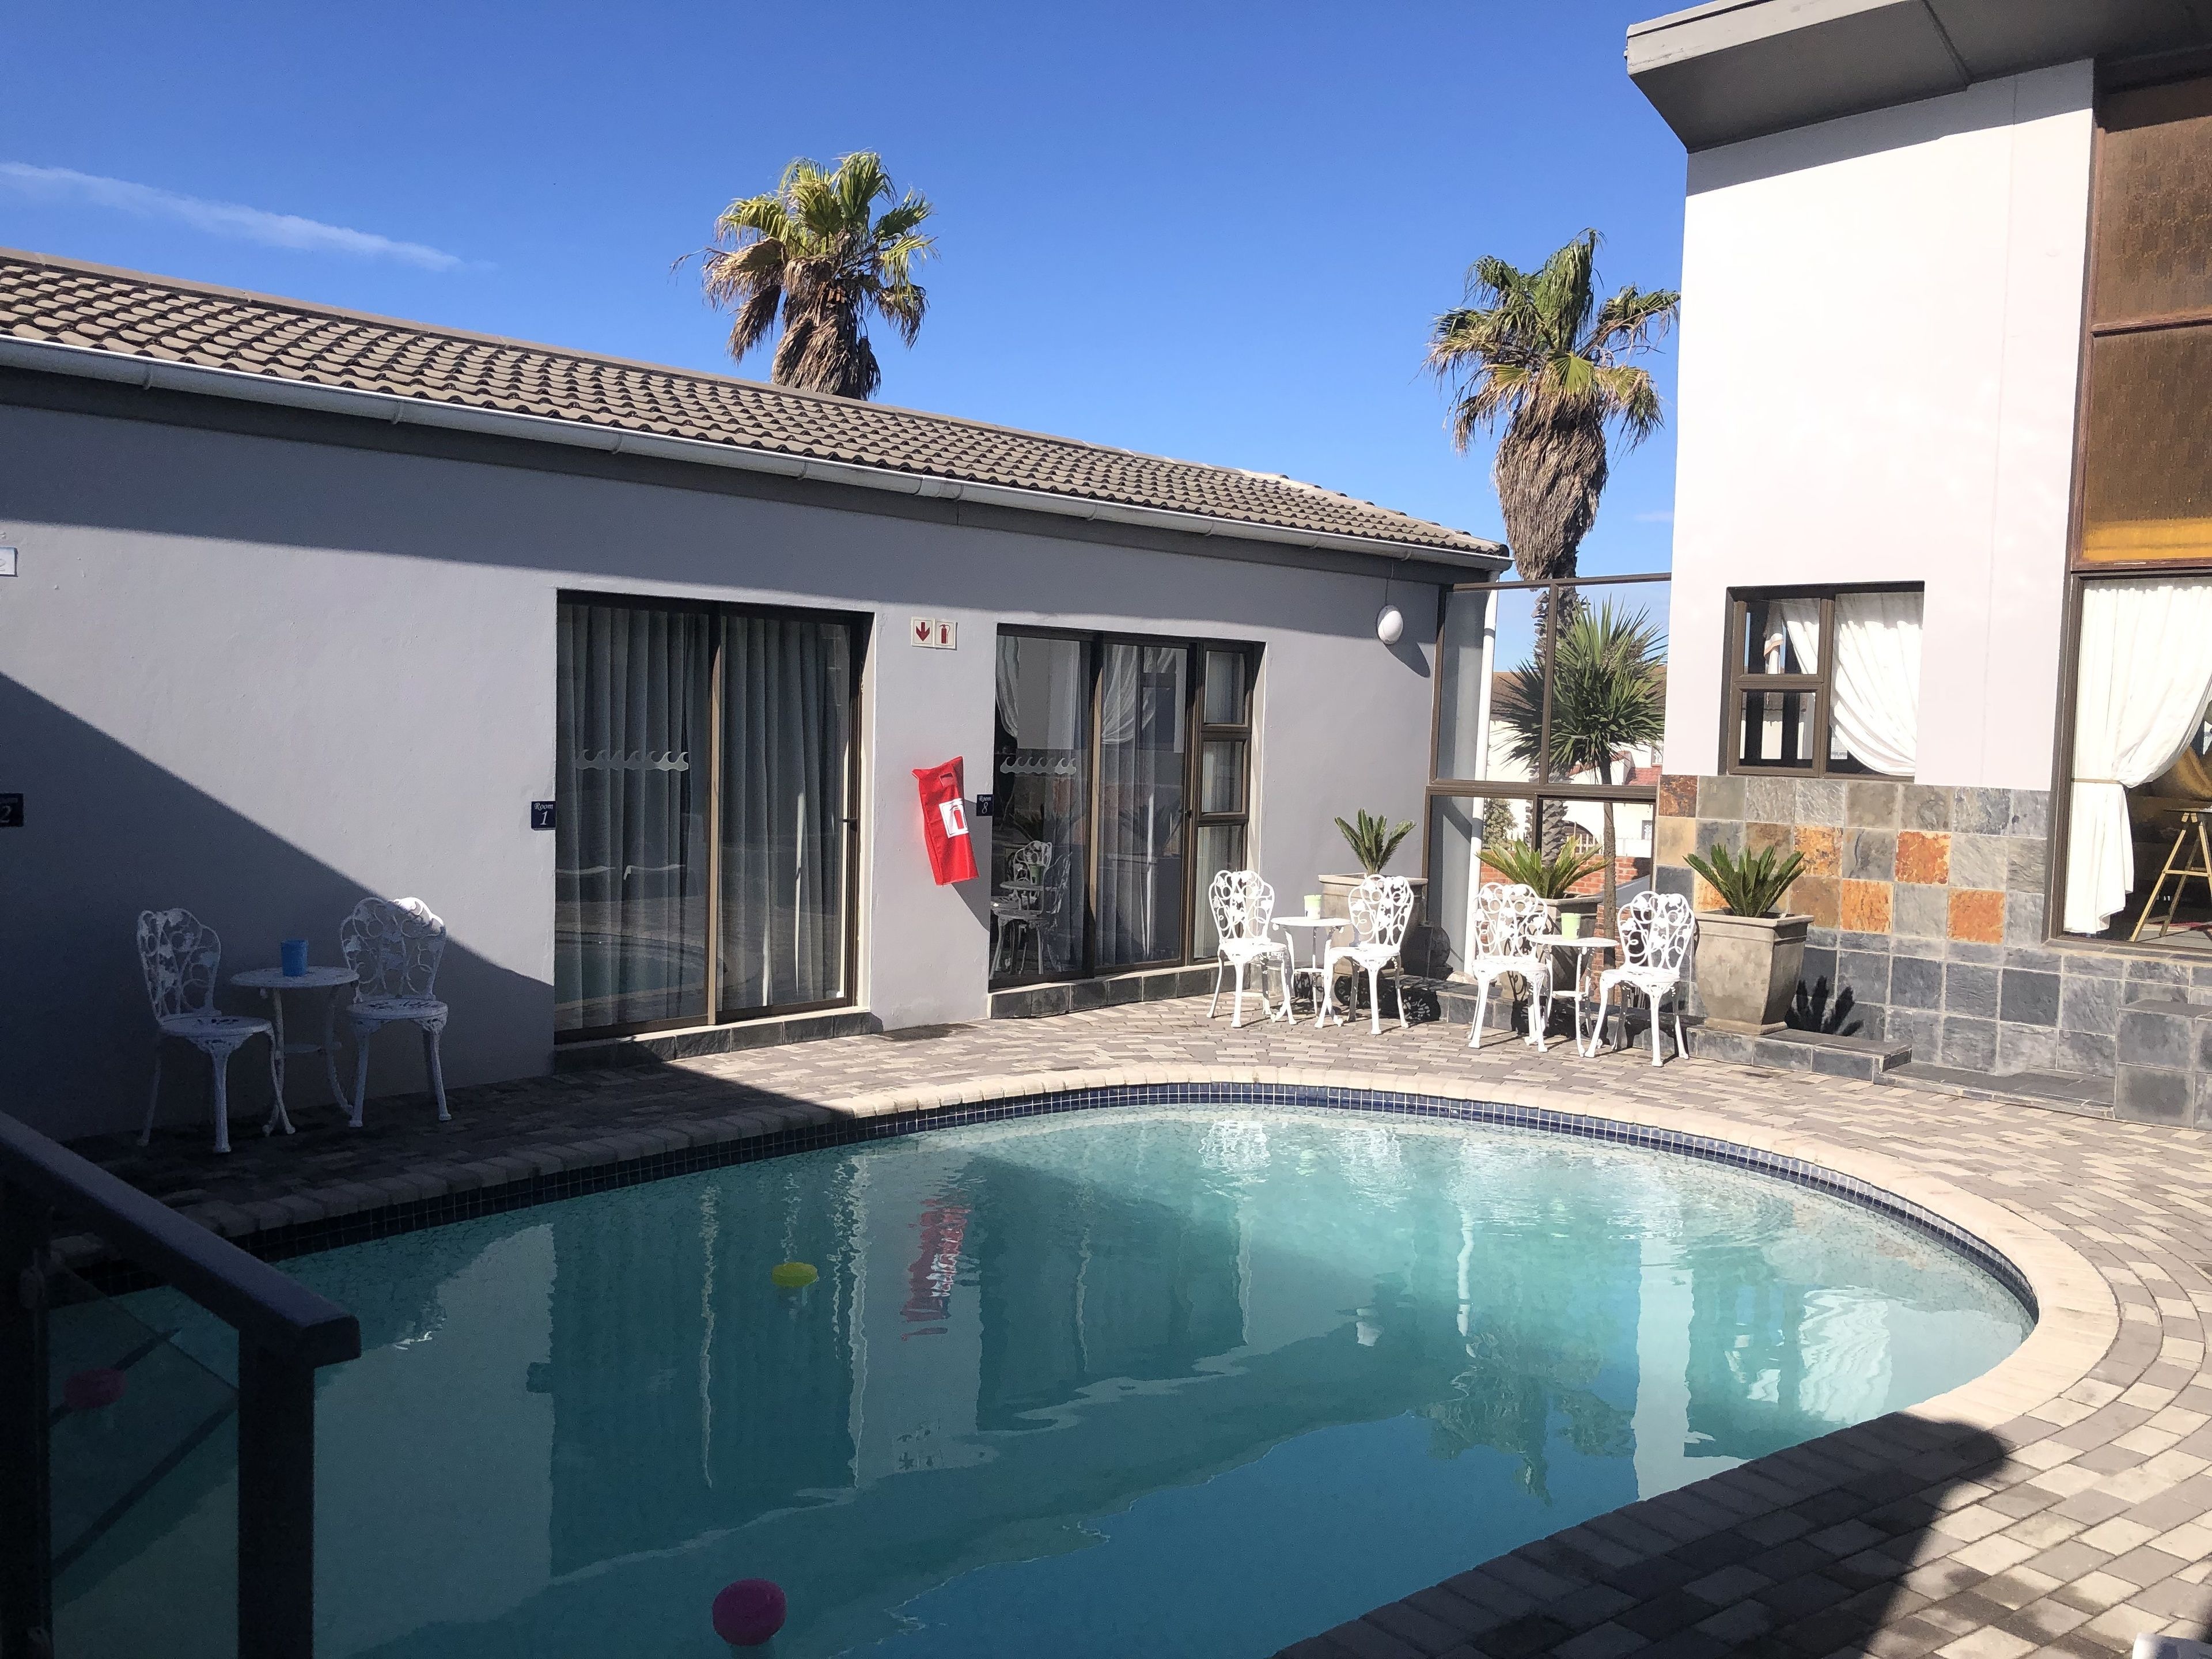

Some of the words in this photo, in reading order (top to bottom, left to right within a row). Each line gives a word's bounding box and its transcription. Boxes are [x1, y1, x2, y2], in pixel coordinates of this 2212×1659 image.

[534, 802, 554, 811] Room
[982, 802, 988, 814] 8
[540, 810, 548, 825] 1
